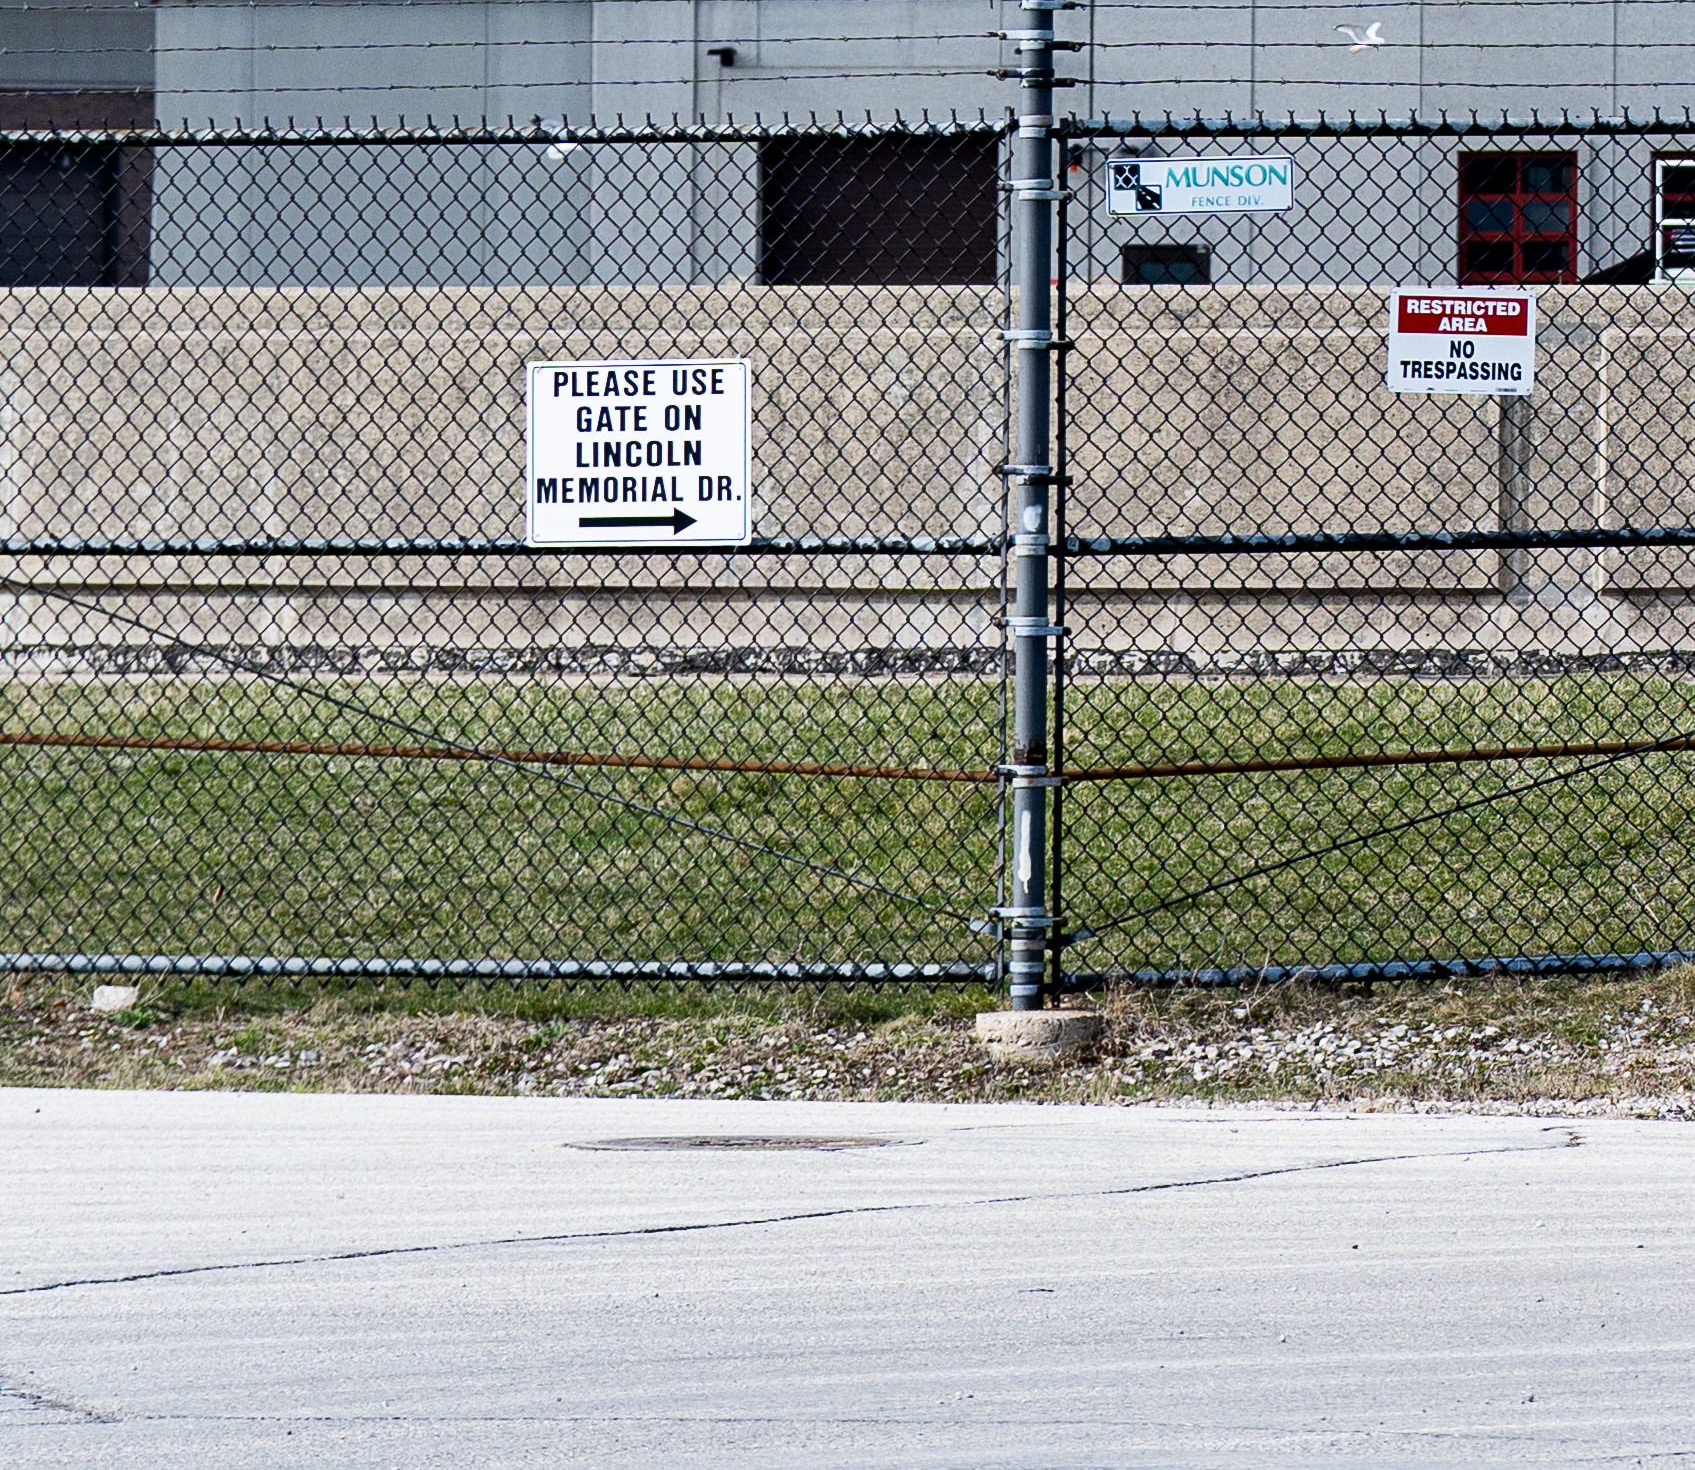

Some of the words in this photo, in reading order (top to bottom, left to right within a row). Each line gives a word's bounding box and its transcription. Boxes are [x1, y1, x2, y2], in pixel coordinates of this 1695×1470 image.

[1166, 164, 1287, 188] MUNSON
[1192, 196, 1230, 206] FENCE
[1238, 196, 1263, 205] DIV.
[1407, 299, 1520, 316] RESTRICTED
[1438, 317, 1487, 332] AREA
[1450, 340, 1474, 358] NO
[1400, 361, 1521, 381] TRESPASSING
[554, 370, 655, 397] PLEASE
[673, 369, 724, 395] USE
[577, 406, 647, 432] GATE
[665, 405, 701, 431] ON
[577, 441, 701, 467] LINCOLN
[537, 476, 683, 503] MEMORIAL
[699, 476, 741, 501] DR.
